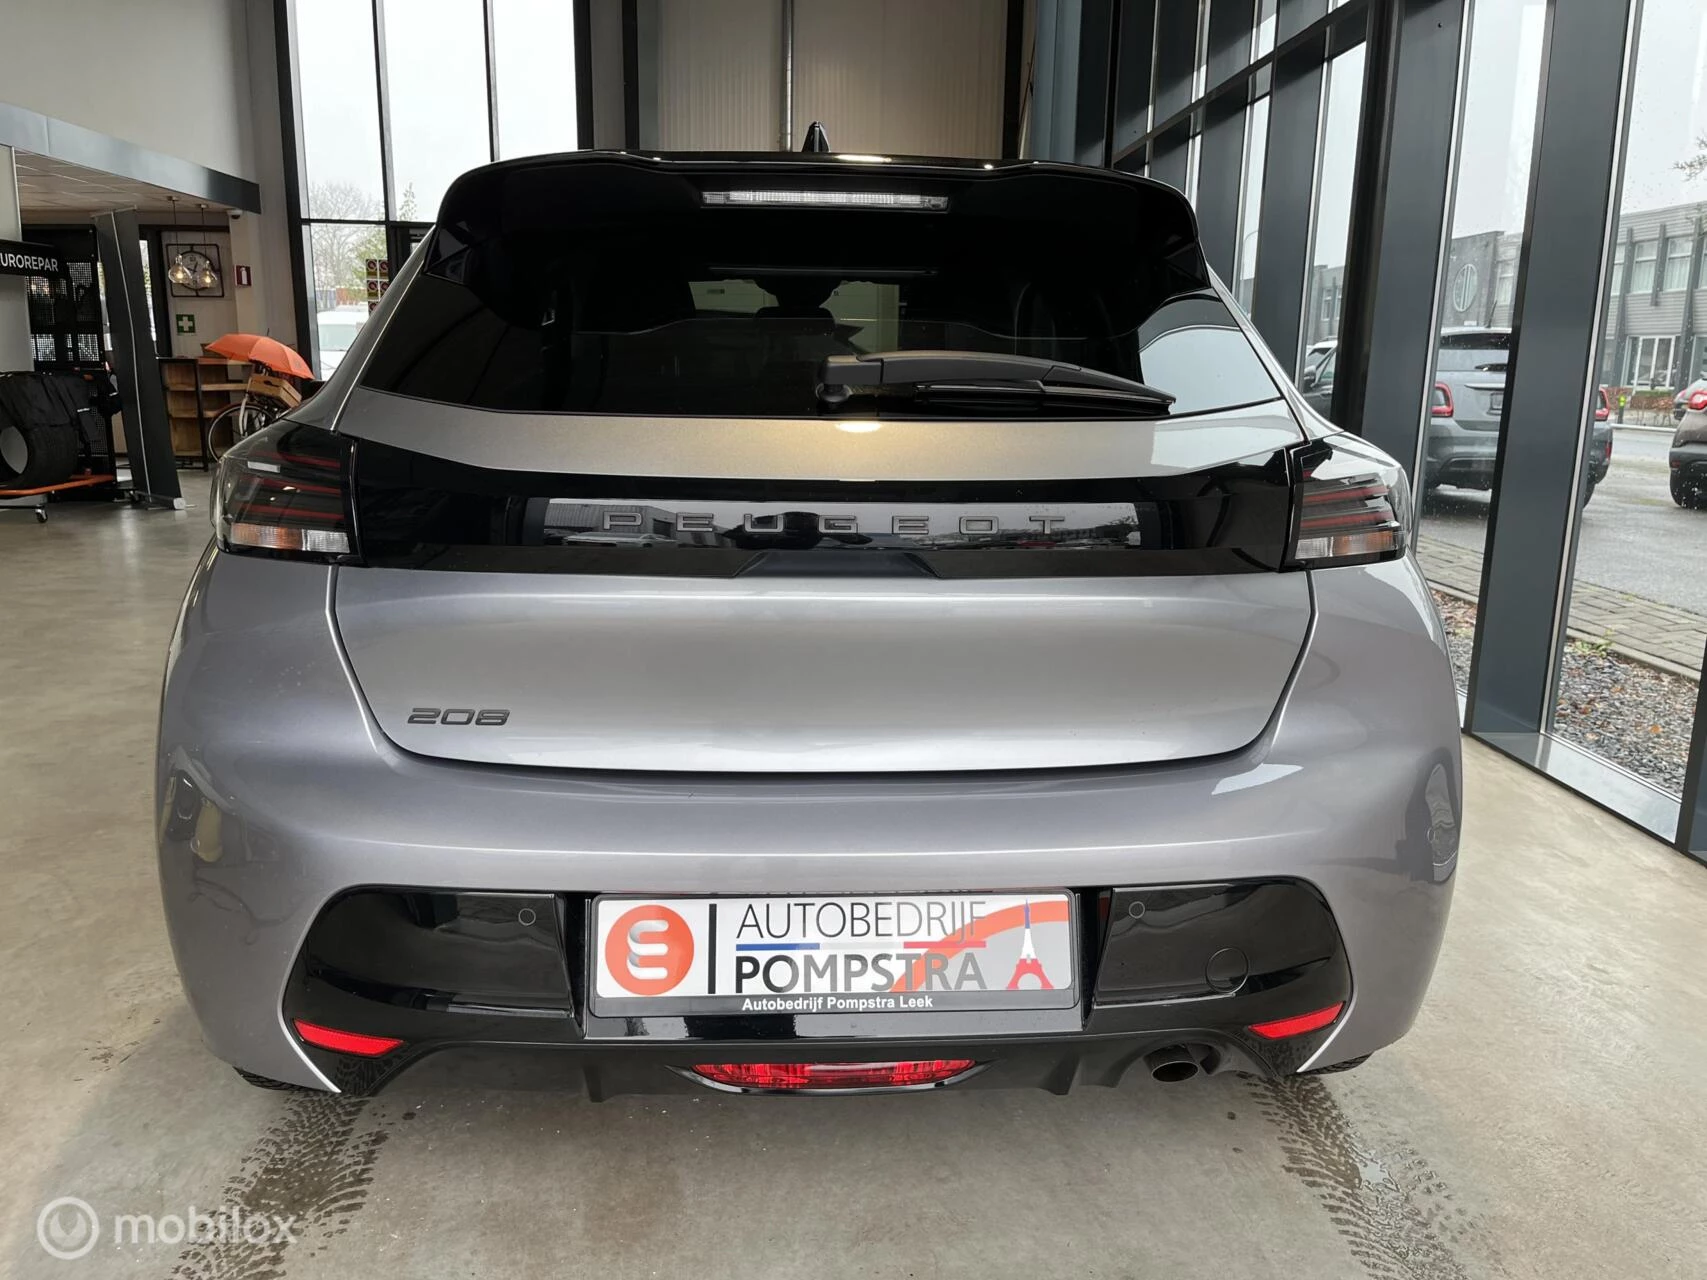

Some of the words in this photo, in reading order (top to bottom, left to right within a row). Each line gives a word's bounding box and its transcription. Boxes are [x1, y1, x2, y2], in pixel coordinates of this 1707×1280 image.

[603, 512, 1066, 534] PEUGEOT
[407, 707, 510, 726] 208
[736, 900, 987, 944] AUTOBEDRIJF
[736, 952, 987, 993] POMPSTRA
[742, 996, 823, 1012] Autobedrijf
[827, 996, 895, 1010] Pompstra
[900, 995, 933, 1008] Leek
